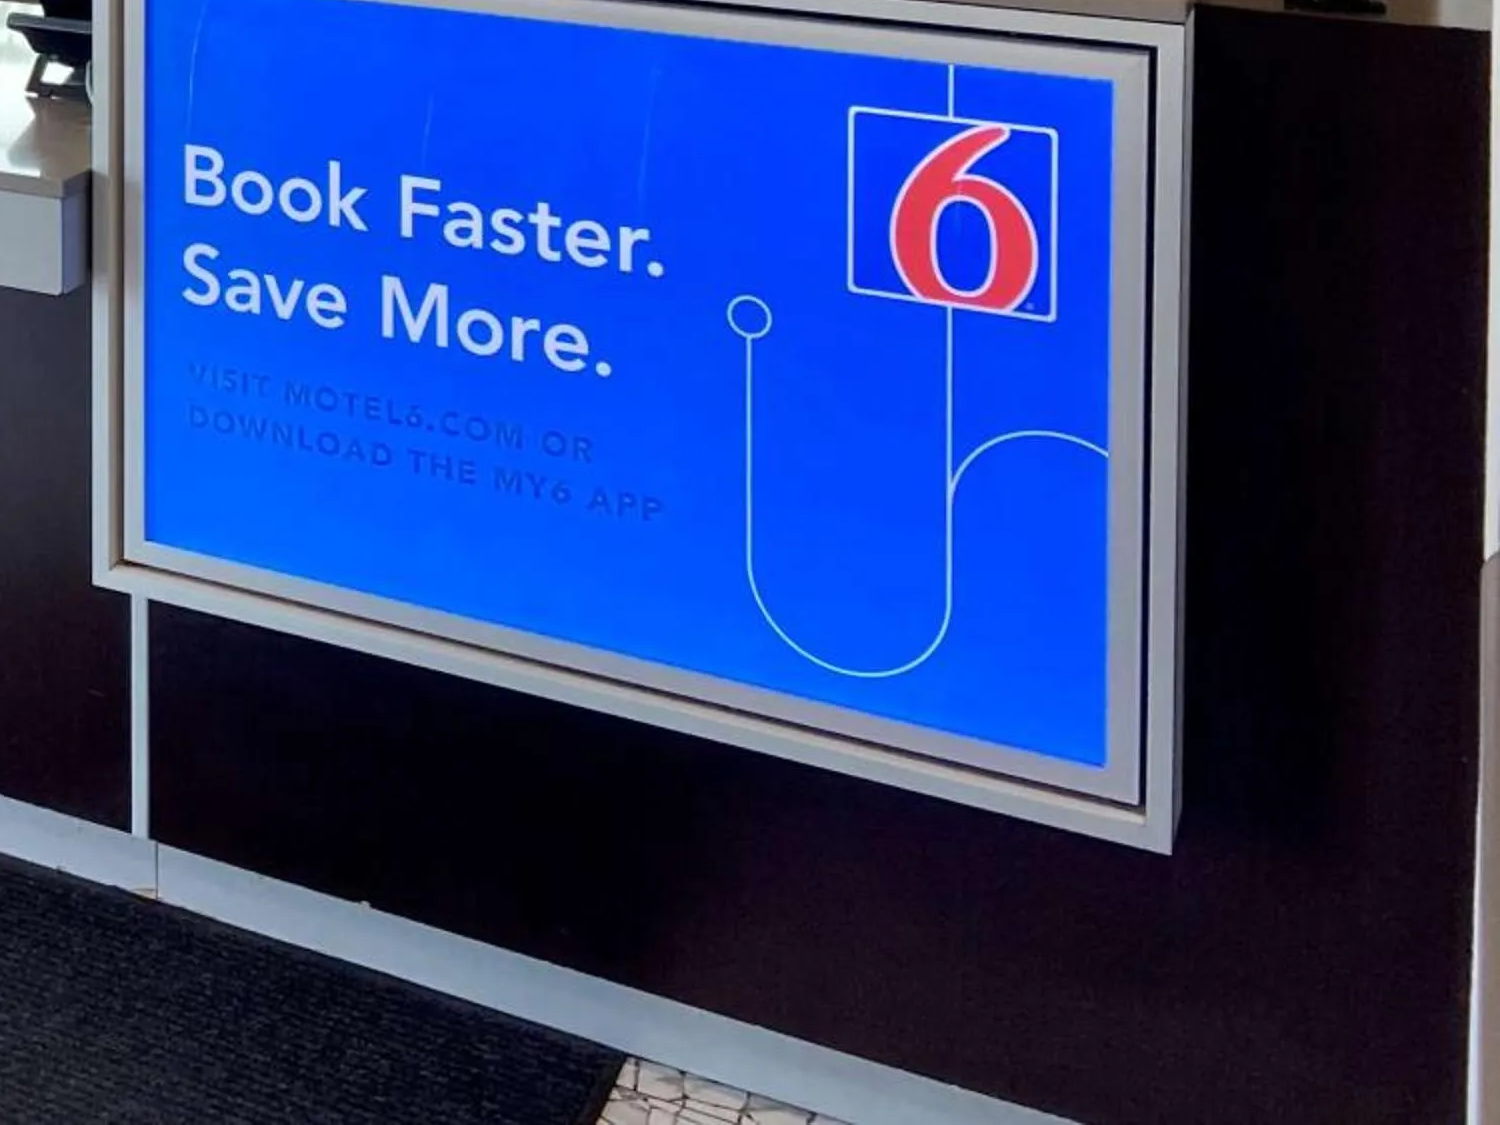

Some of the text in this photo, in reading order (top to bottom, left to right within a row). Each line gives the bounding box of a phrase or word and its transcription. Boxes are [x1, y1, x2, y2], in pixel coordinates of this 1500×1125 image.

[184, 143, 665, 278] Book Faster.
[889, 121, 1039, 314] 6
[182, 242, 612, 377] Save More.
[188, 361, 594, 463] VISIT MOTEL6.COM OR
[189, 404, 663, 522] DOWNLOAD THE MY6 APP
